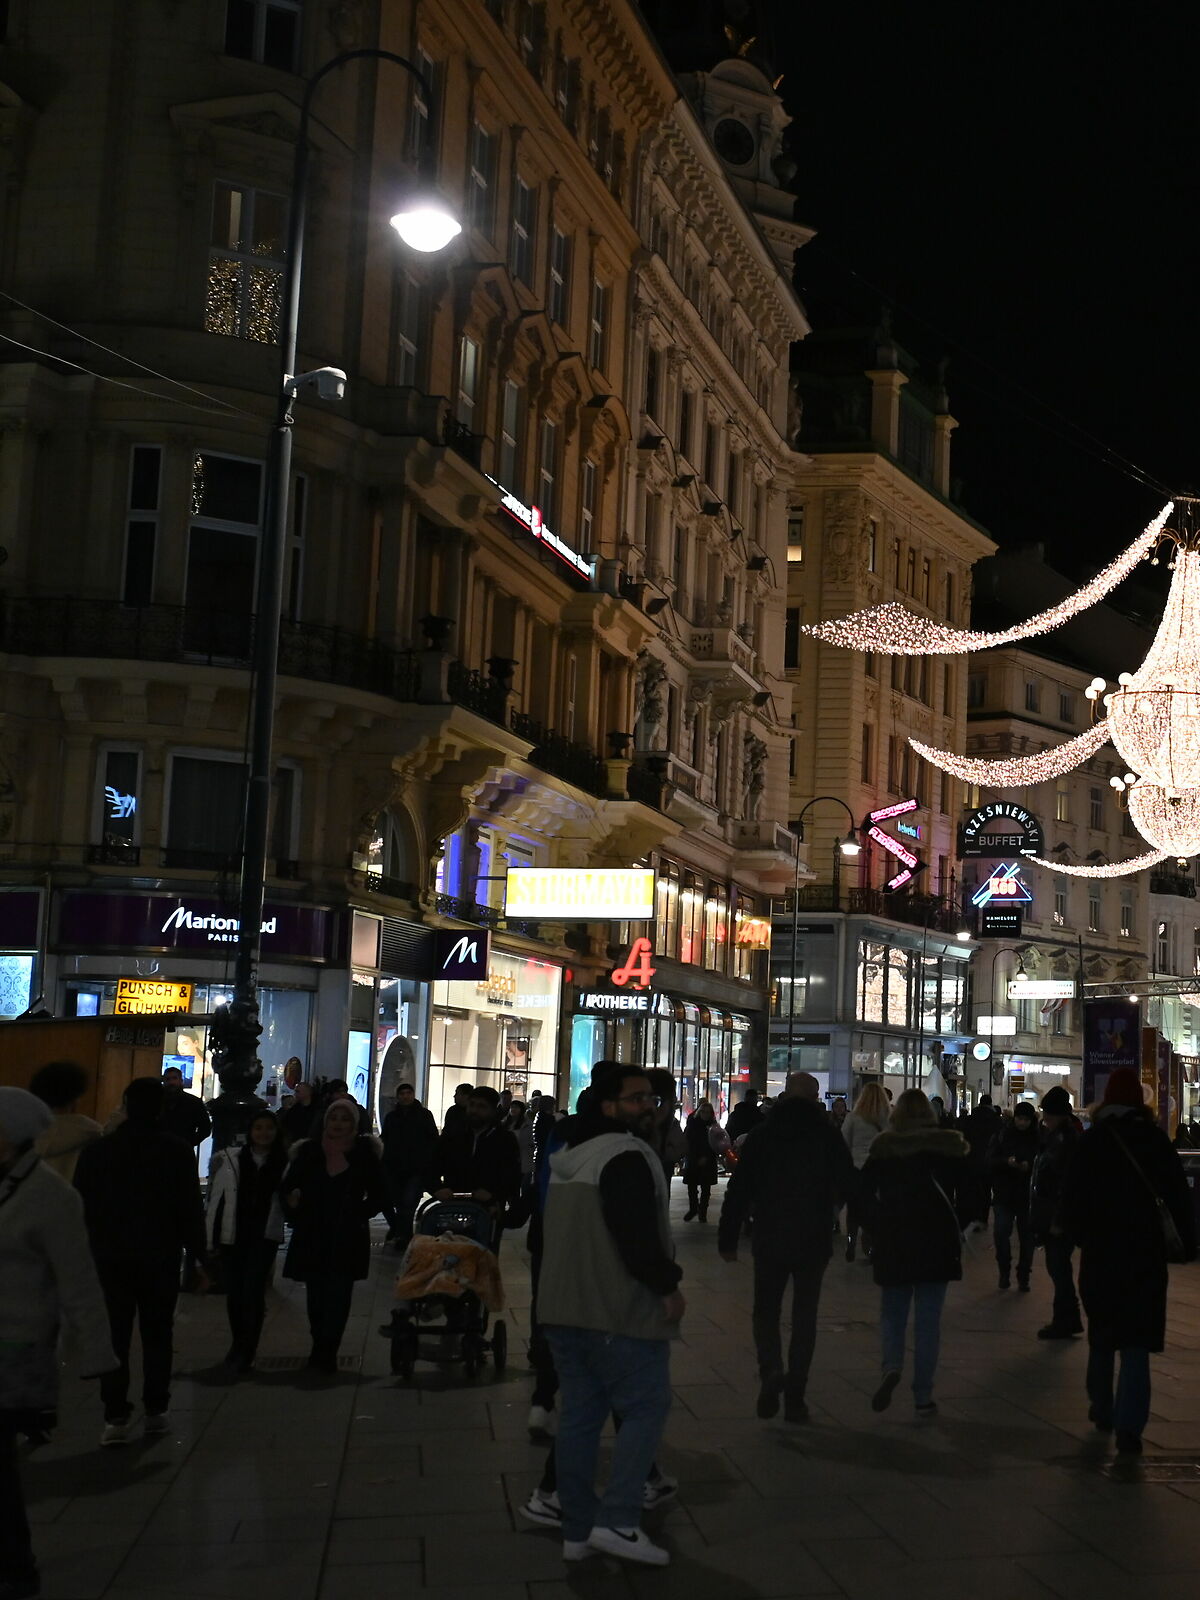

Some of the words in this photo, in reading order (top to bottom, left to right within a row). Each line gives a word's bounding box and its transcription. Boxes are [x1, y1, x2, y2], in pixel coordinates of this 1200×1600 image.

[965, 804, 1039, 843] TRZESNIEWSKI
[979, 836, 1024, 846] BUFFET
[161, 906, 277, 934] Marionud
[207, 933, 240, 943] PARIS
[119, 981, 173, 997] PUNSCH
[179, 986, 188, 998] &
[586, 993, 648, 1010] APOTHEKE
